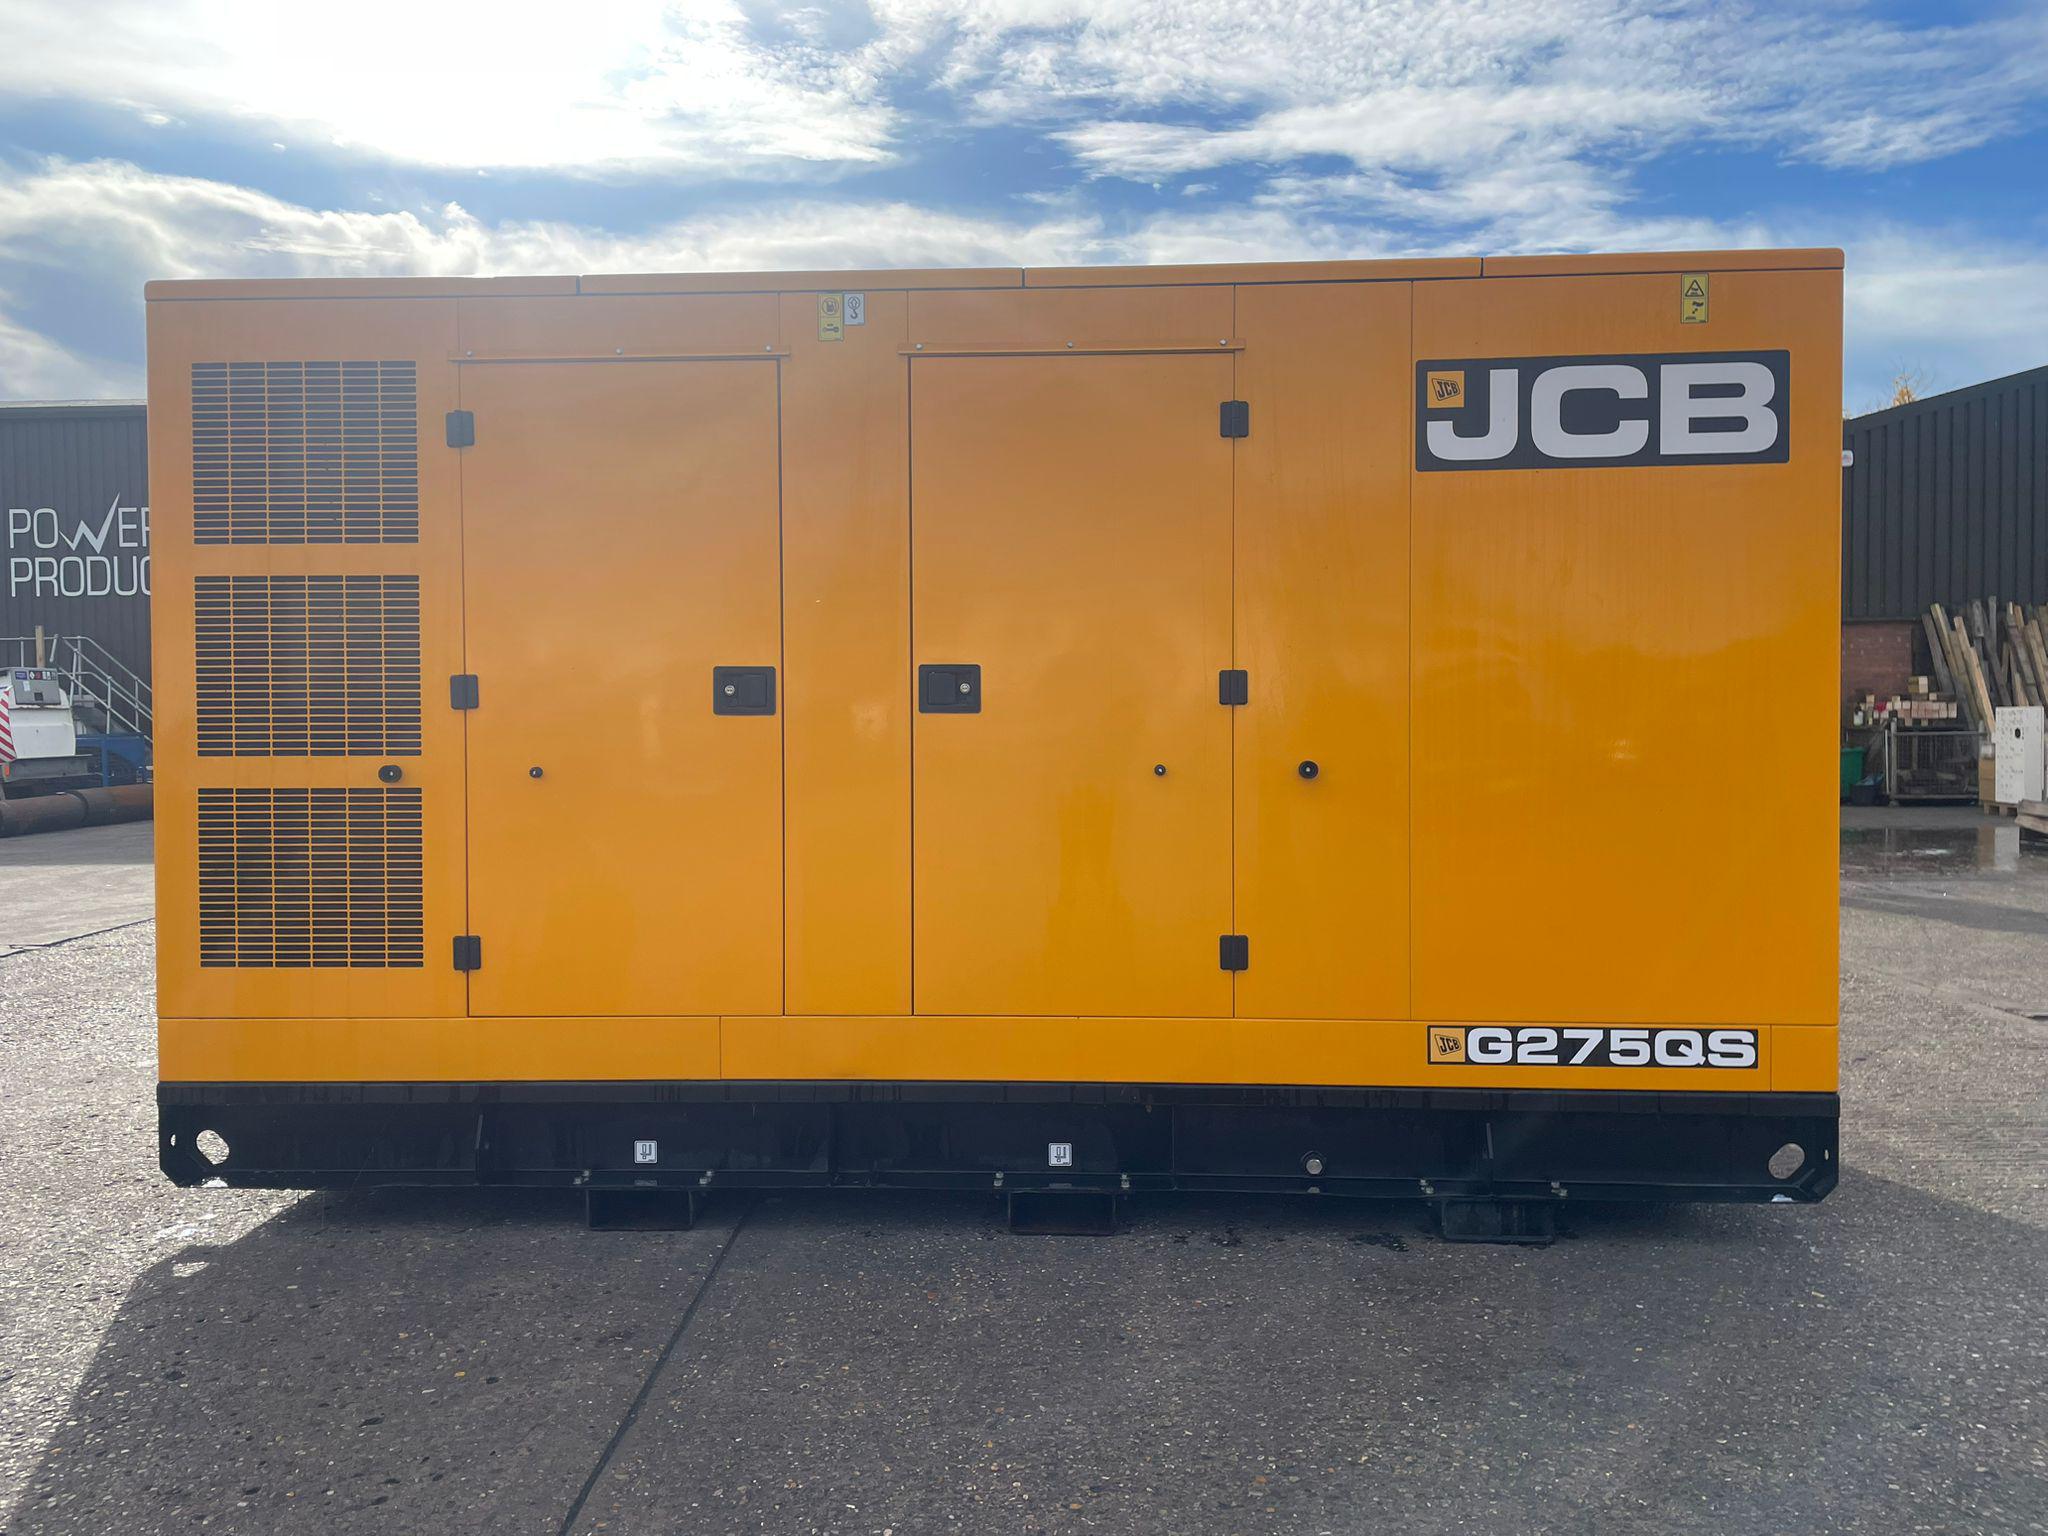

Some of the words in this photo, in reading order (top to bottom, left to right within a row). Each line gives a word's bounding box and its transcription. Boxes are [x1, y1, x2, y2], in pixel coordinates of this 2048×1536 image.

[1436, 380, 1459, 399] JCB
[1427, 362, 1778, 460] JCB
[1439, 1036, 1460, 1053] JCB
[1467, 1027, 1756, 1067] G275QS
